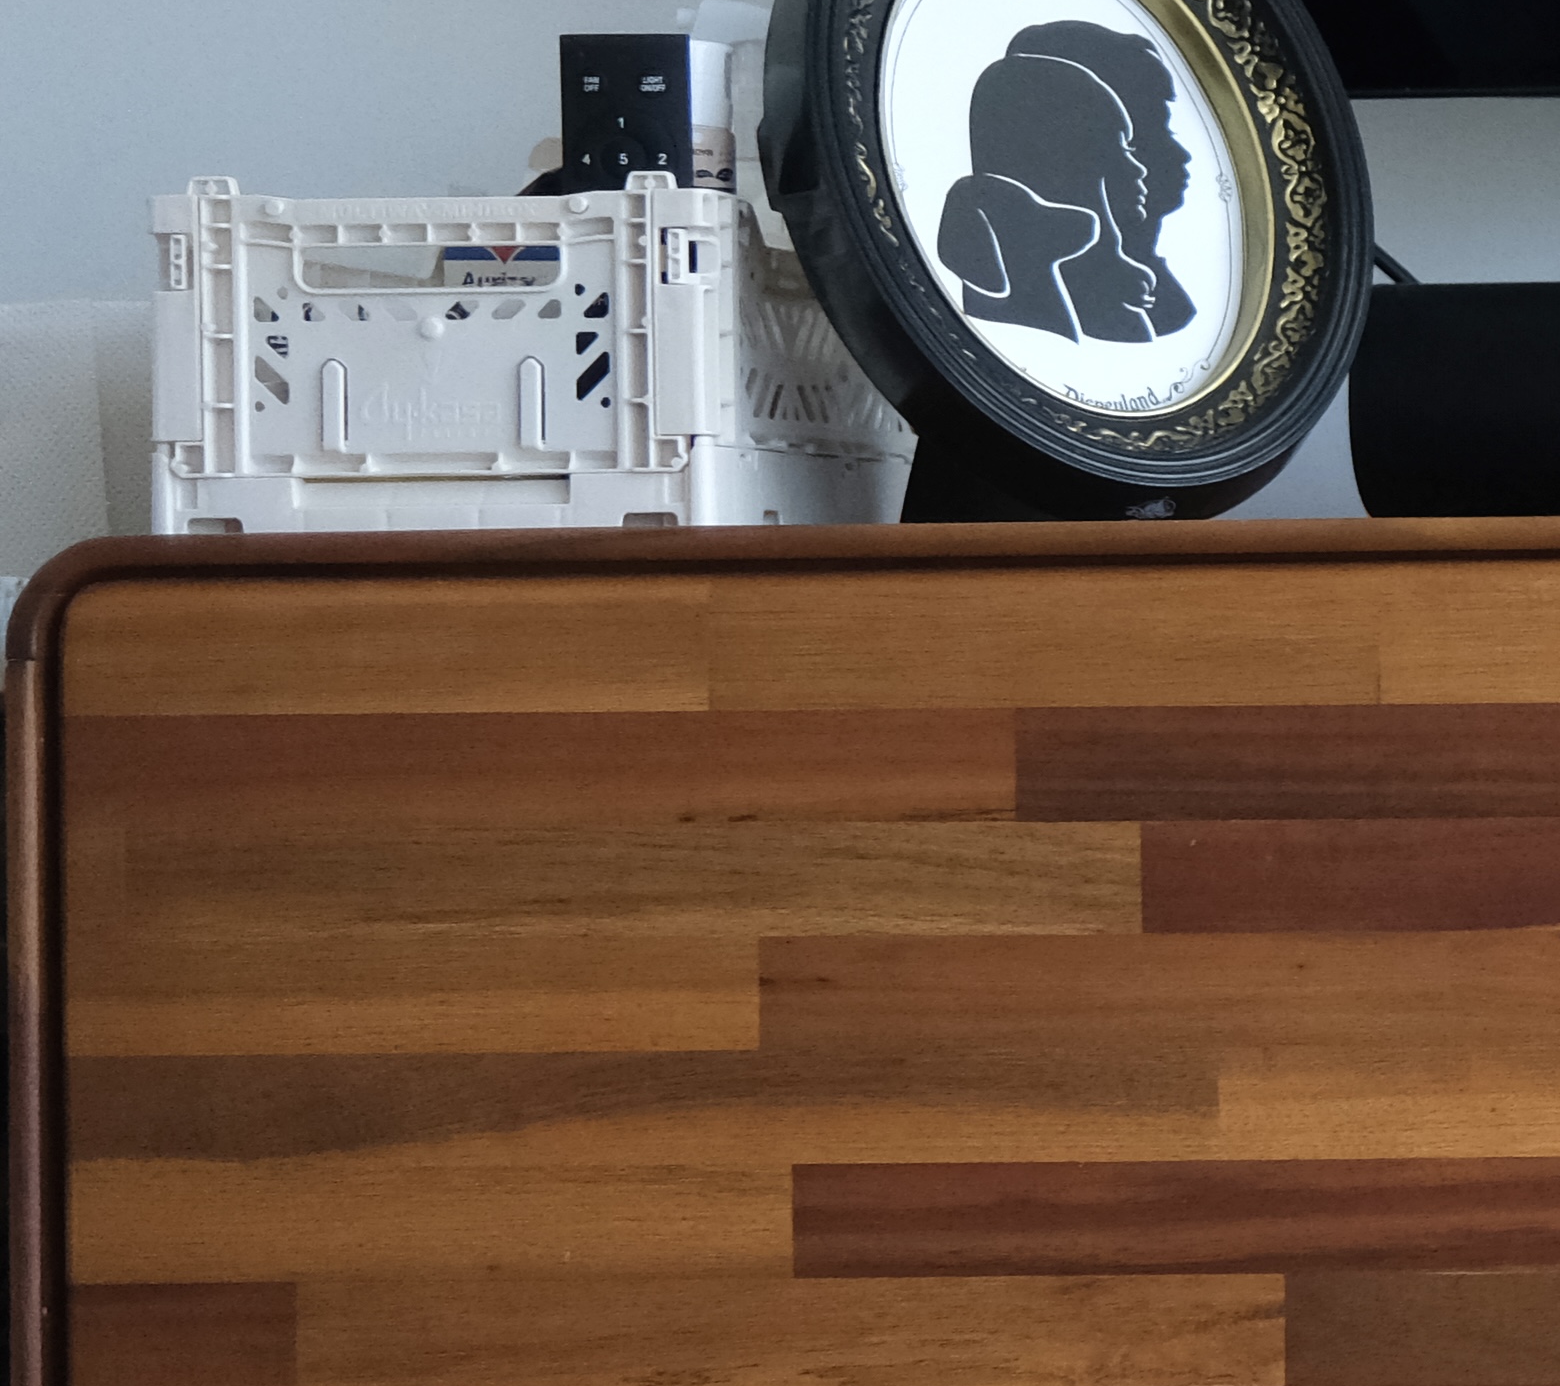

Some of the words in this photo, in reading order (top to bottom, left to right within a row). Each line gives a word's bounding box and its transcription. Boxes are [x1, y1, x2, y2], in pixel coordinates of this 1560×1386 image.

[617, 117, 625, 129] 1
[581, 153, 591, 165] 4
[619, 153, 629, 165] 5
[658, 153, 668, 165] 2
